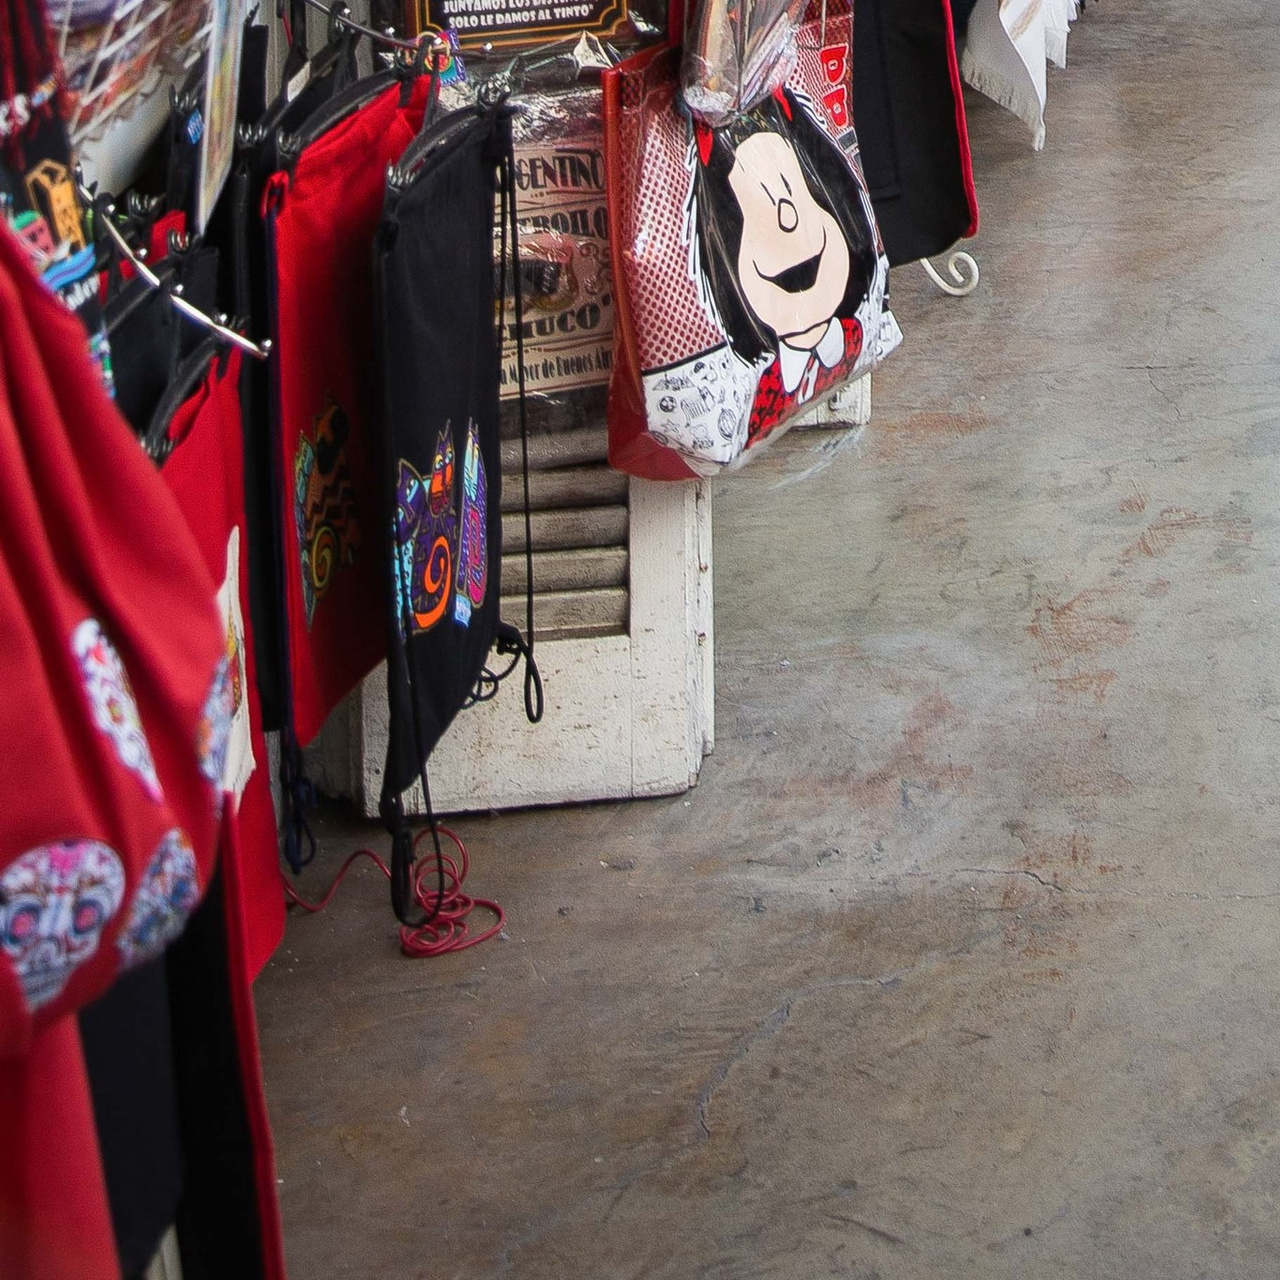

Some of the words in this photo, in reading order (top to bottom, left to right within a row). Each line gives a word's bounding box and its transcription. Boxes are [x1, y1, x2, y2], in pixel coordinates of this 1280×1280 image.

[449, 14, 479, 30] SOLO
[480, 13, 495, 27] LE
[496, 9, 536, 25] DAMOS
[537, 7, 553, 21] AL
[554, 2, 595, 19] TINTO"
[542, 359, 556, 379] de
